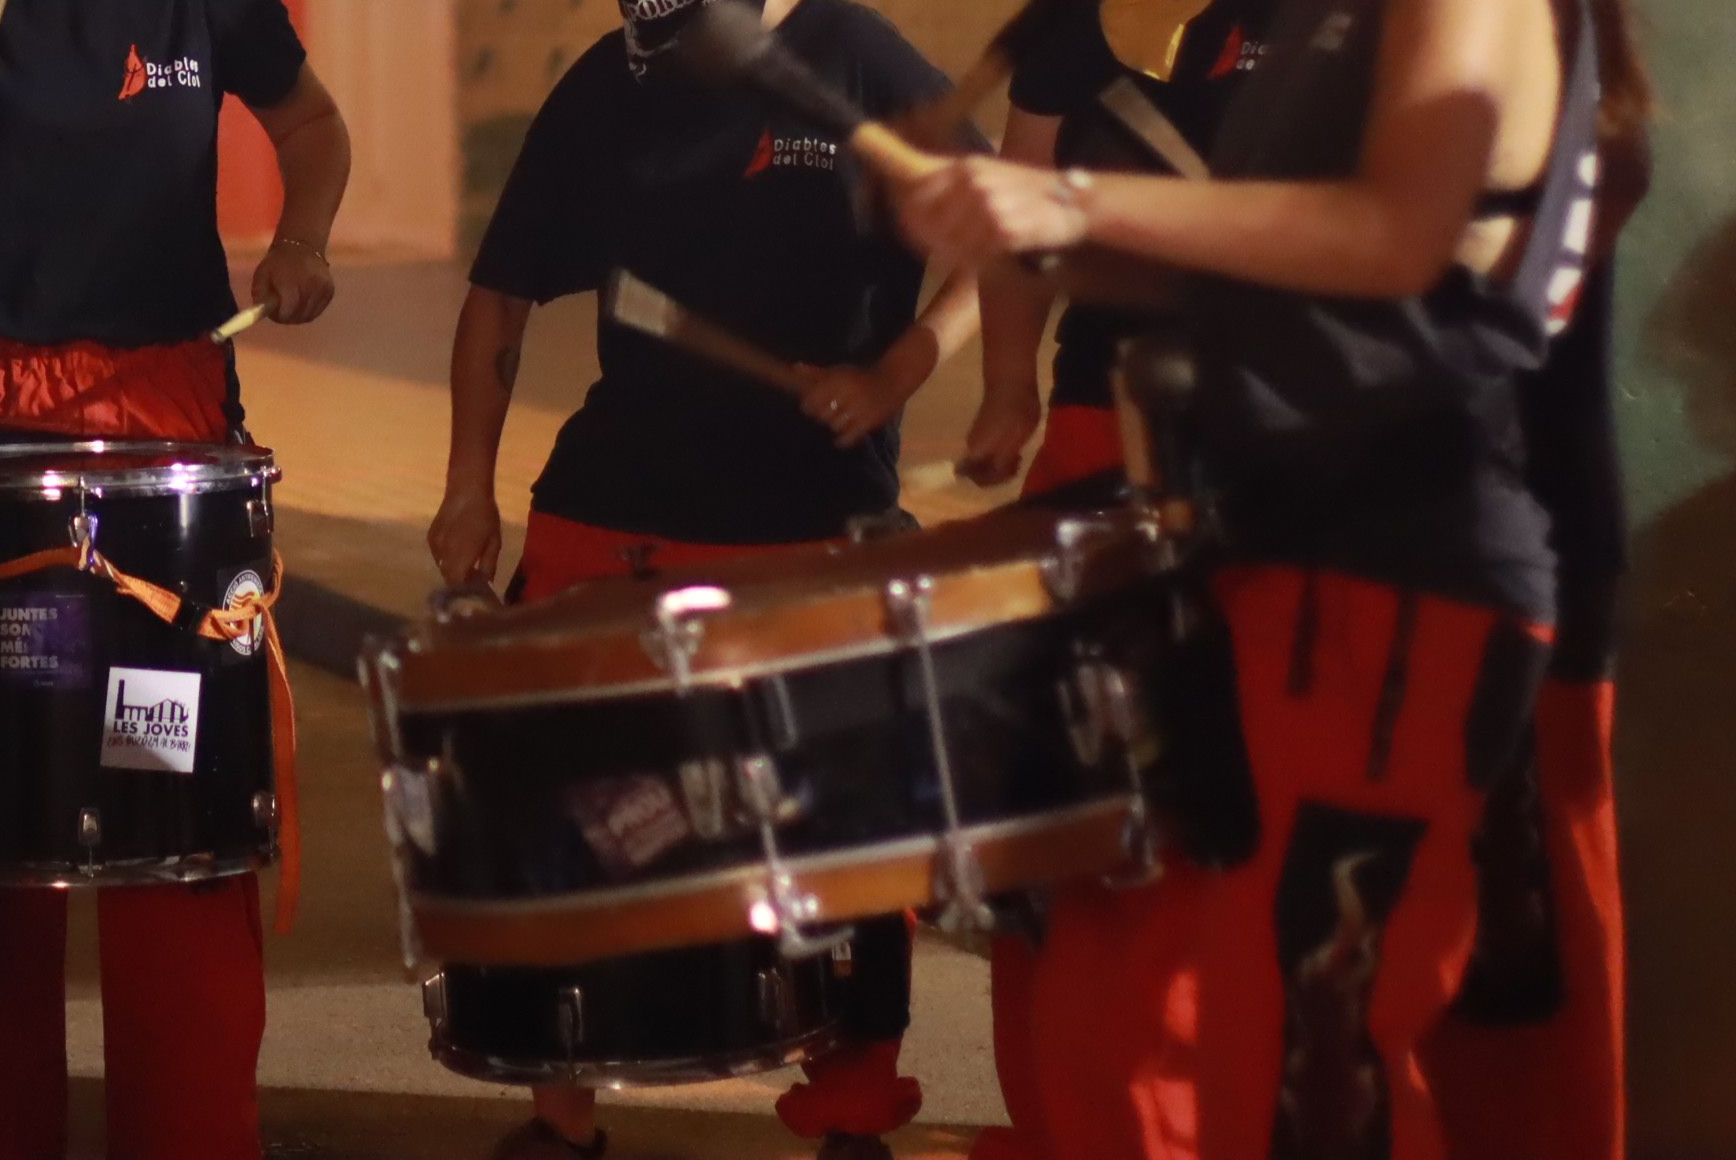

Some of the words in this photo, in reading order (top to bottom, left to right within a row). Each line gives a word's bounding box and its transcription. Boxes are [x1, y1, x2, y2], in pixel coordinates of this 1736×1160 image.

[147, 75, 172, 88] del
[773, 136, 837, 155] Diables
[772, 152, 797, 166] del
[0, 607, 58, 622] JUNTES
[0, 655, 59, 669] FORTES
[113, 720, 138, 734] LES
[143, 722, 189, 738] JOVES
